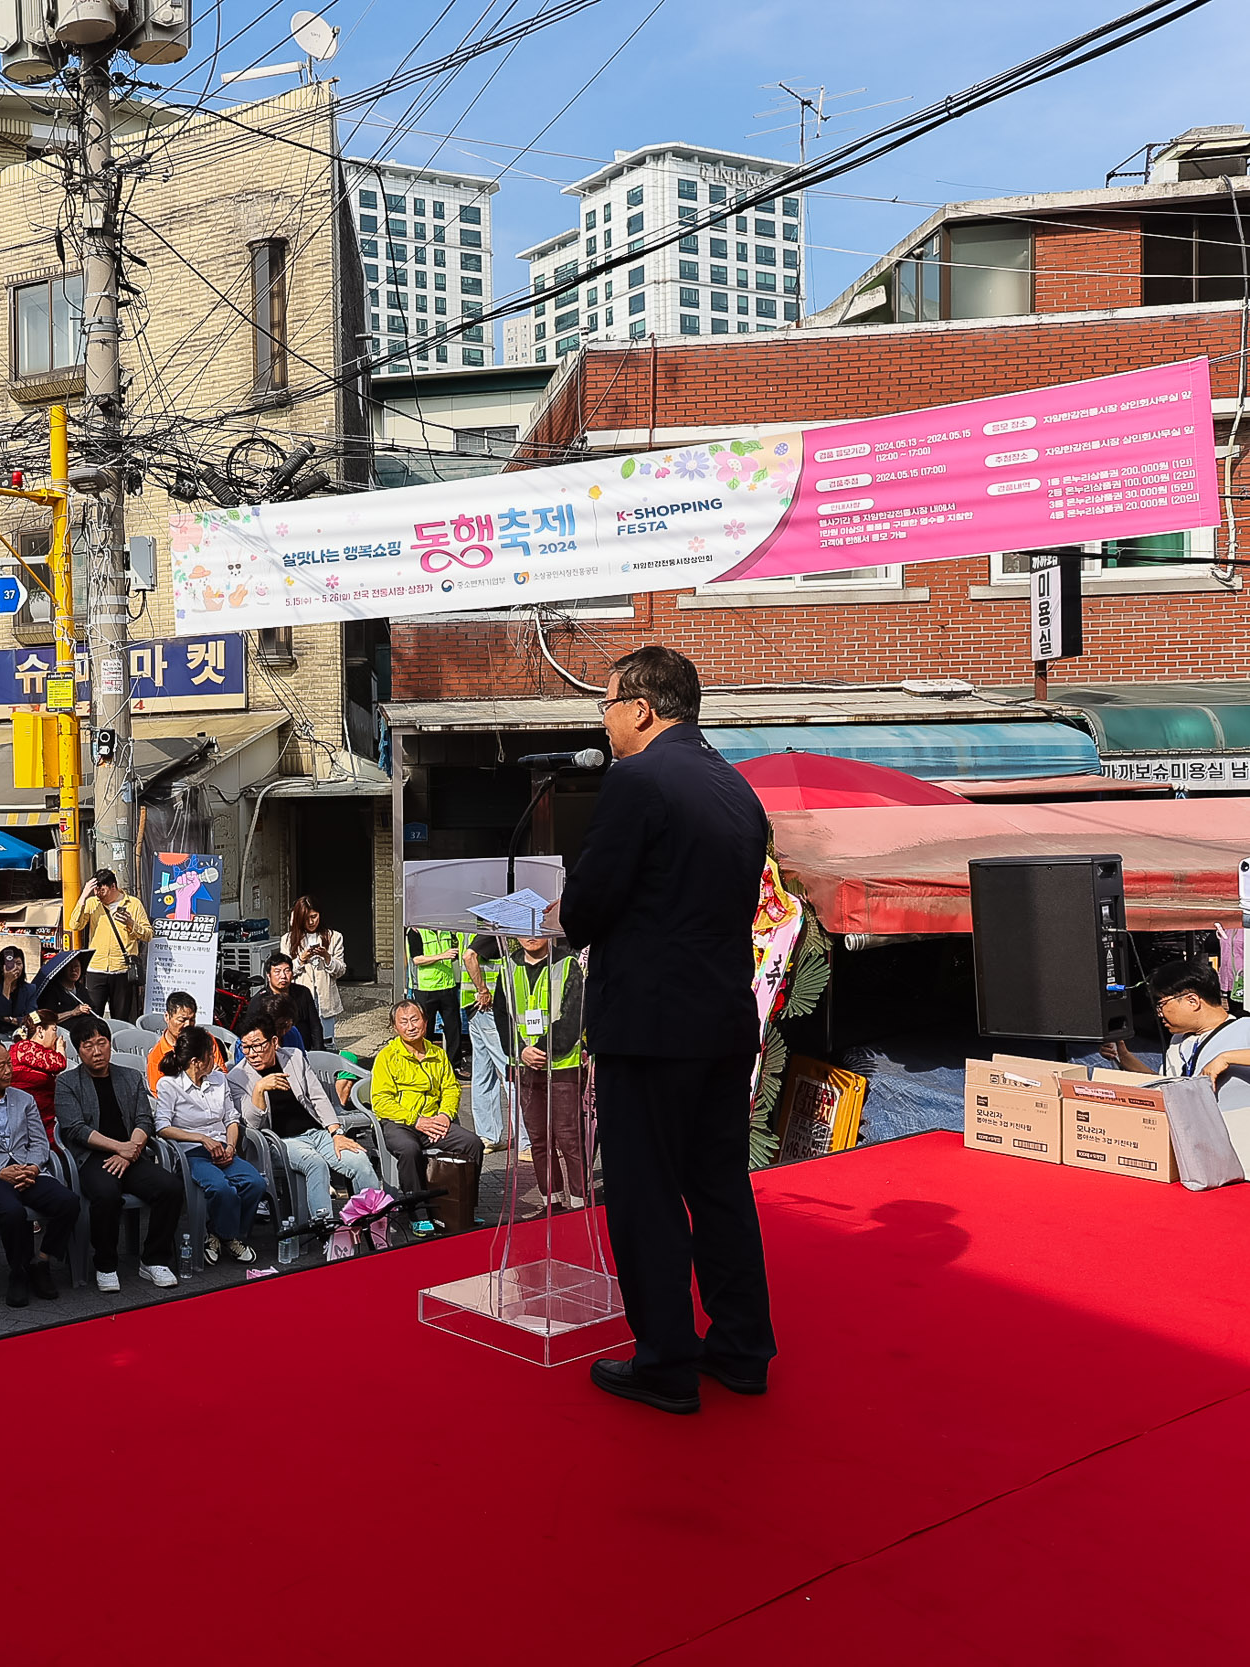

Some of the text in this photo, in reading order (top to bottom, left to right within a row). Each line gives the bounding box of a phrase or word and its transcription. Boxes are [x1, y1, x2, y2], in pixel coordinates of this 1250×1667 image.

[1043, 390, 1192, 424] 자양한강전통시장 상인회사무실 앞
[1011, 419, 1028, 430] 장소
[874, 437, 918, 452] 2024.05.13
[927, 429, 972, 444] 2024.05.15
[1045, 425, 1195, 457] 자양한강전통시장 상인회사무실 앞
[875, 464, 947, 483] 2024.05.15 (17:00)
[1046, 477, 1061, 487] 1등
[1062, 469, 1119, 485] 온누리상품권
[1172, 457, 1193, 469] (1인)
[1047, 488, 1063, 498] 2등
[1065, 480, 1122, 496] 온누리상품권
[1173, 469, 1196, 481] (2인)
[1049, 499, 1064, 510] 3등
[1066, 491, 1123, 507] 온누리상품권
[1170, 482, 1194, 493] (5인)
[616, 497, 723, 522] K-SHOPPING
[819, 516, 851, 528] 행사기간
[863, 506, 928, 522] 자양한강전통시장
[930, 502, 956, 514] 내에서
[1049, 510, 1065, 520] 4등
[1067, 503, 1124, 518] 온누리상품권
[1171, 493, 1200, 505] (20인)
[617, 520, 668, 536] FESTA
[819, 528, 839, 538] 1만원
[840, 524, 864, 536] 이상의
[893, 518, 918, 529] 구매한
[410, 504, 577, 573] 동행축제
[538, 539, 578, 555] 2024
[819, 537, 844, 549] 고객에
[845, 534, 870, 546] 한해서
[890, 529, 908, 540] 가능
[282, 540, 402, 568] 살맛나는 행복쇼핑
[632, 553, 714, 570] 자양한강전통시장상인회
[457, 576, 507, 590] 중소벤처기업부
[533, 566, 599, 581] 소상공인시장진흥공단
[3, 590, 16, 599] 37
[285, 597, 312, 607] 5.15(수)
[353, 589, 370, 600] 전국
[1038, 571, 1053, 655] 미용실
[1101, 762, 1250, 781] 까까보슈미용실 남
[409, 831, 421, 840] 37
[154, 920, 213, 932] SHOW ME
[526, 1018, 542, 1026] STAFF
[976, 1109, 1003, 1119] 모나리자
[1076, 1125, 1106, 1135] 모나리자
